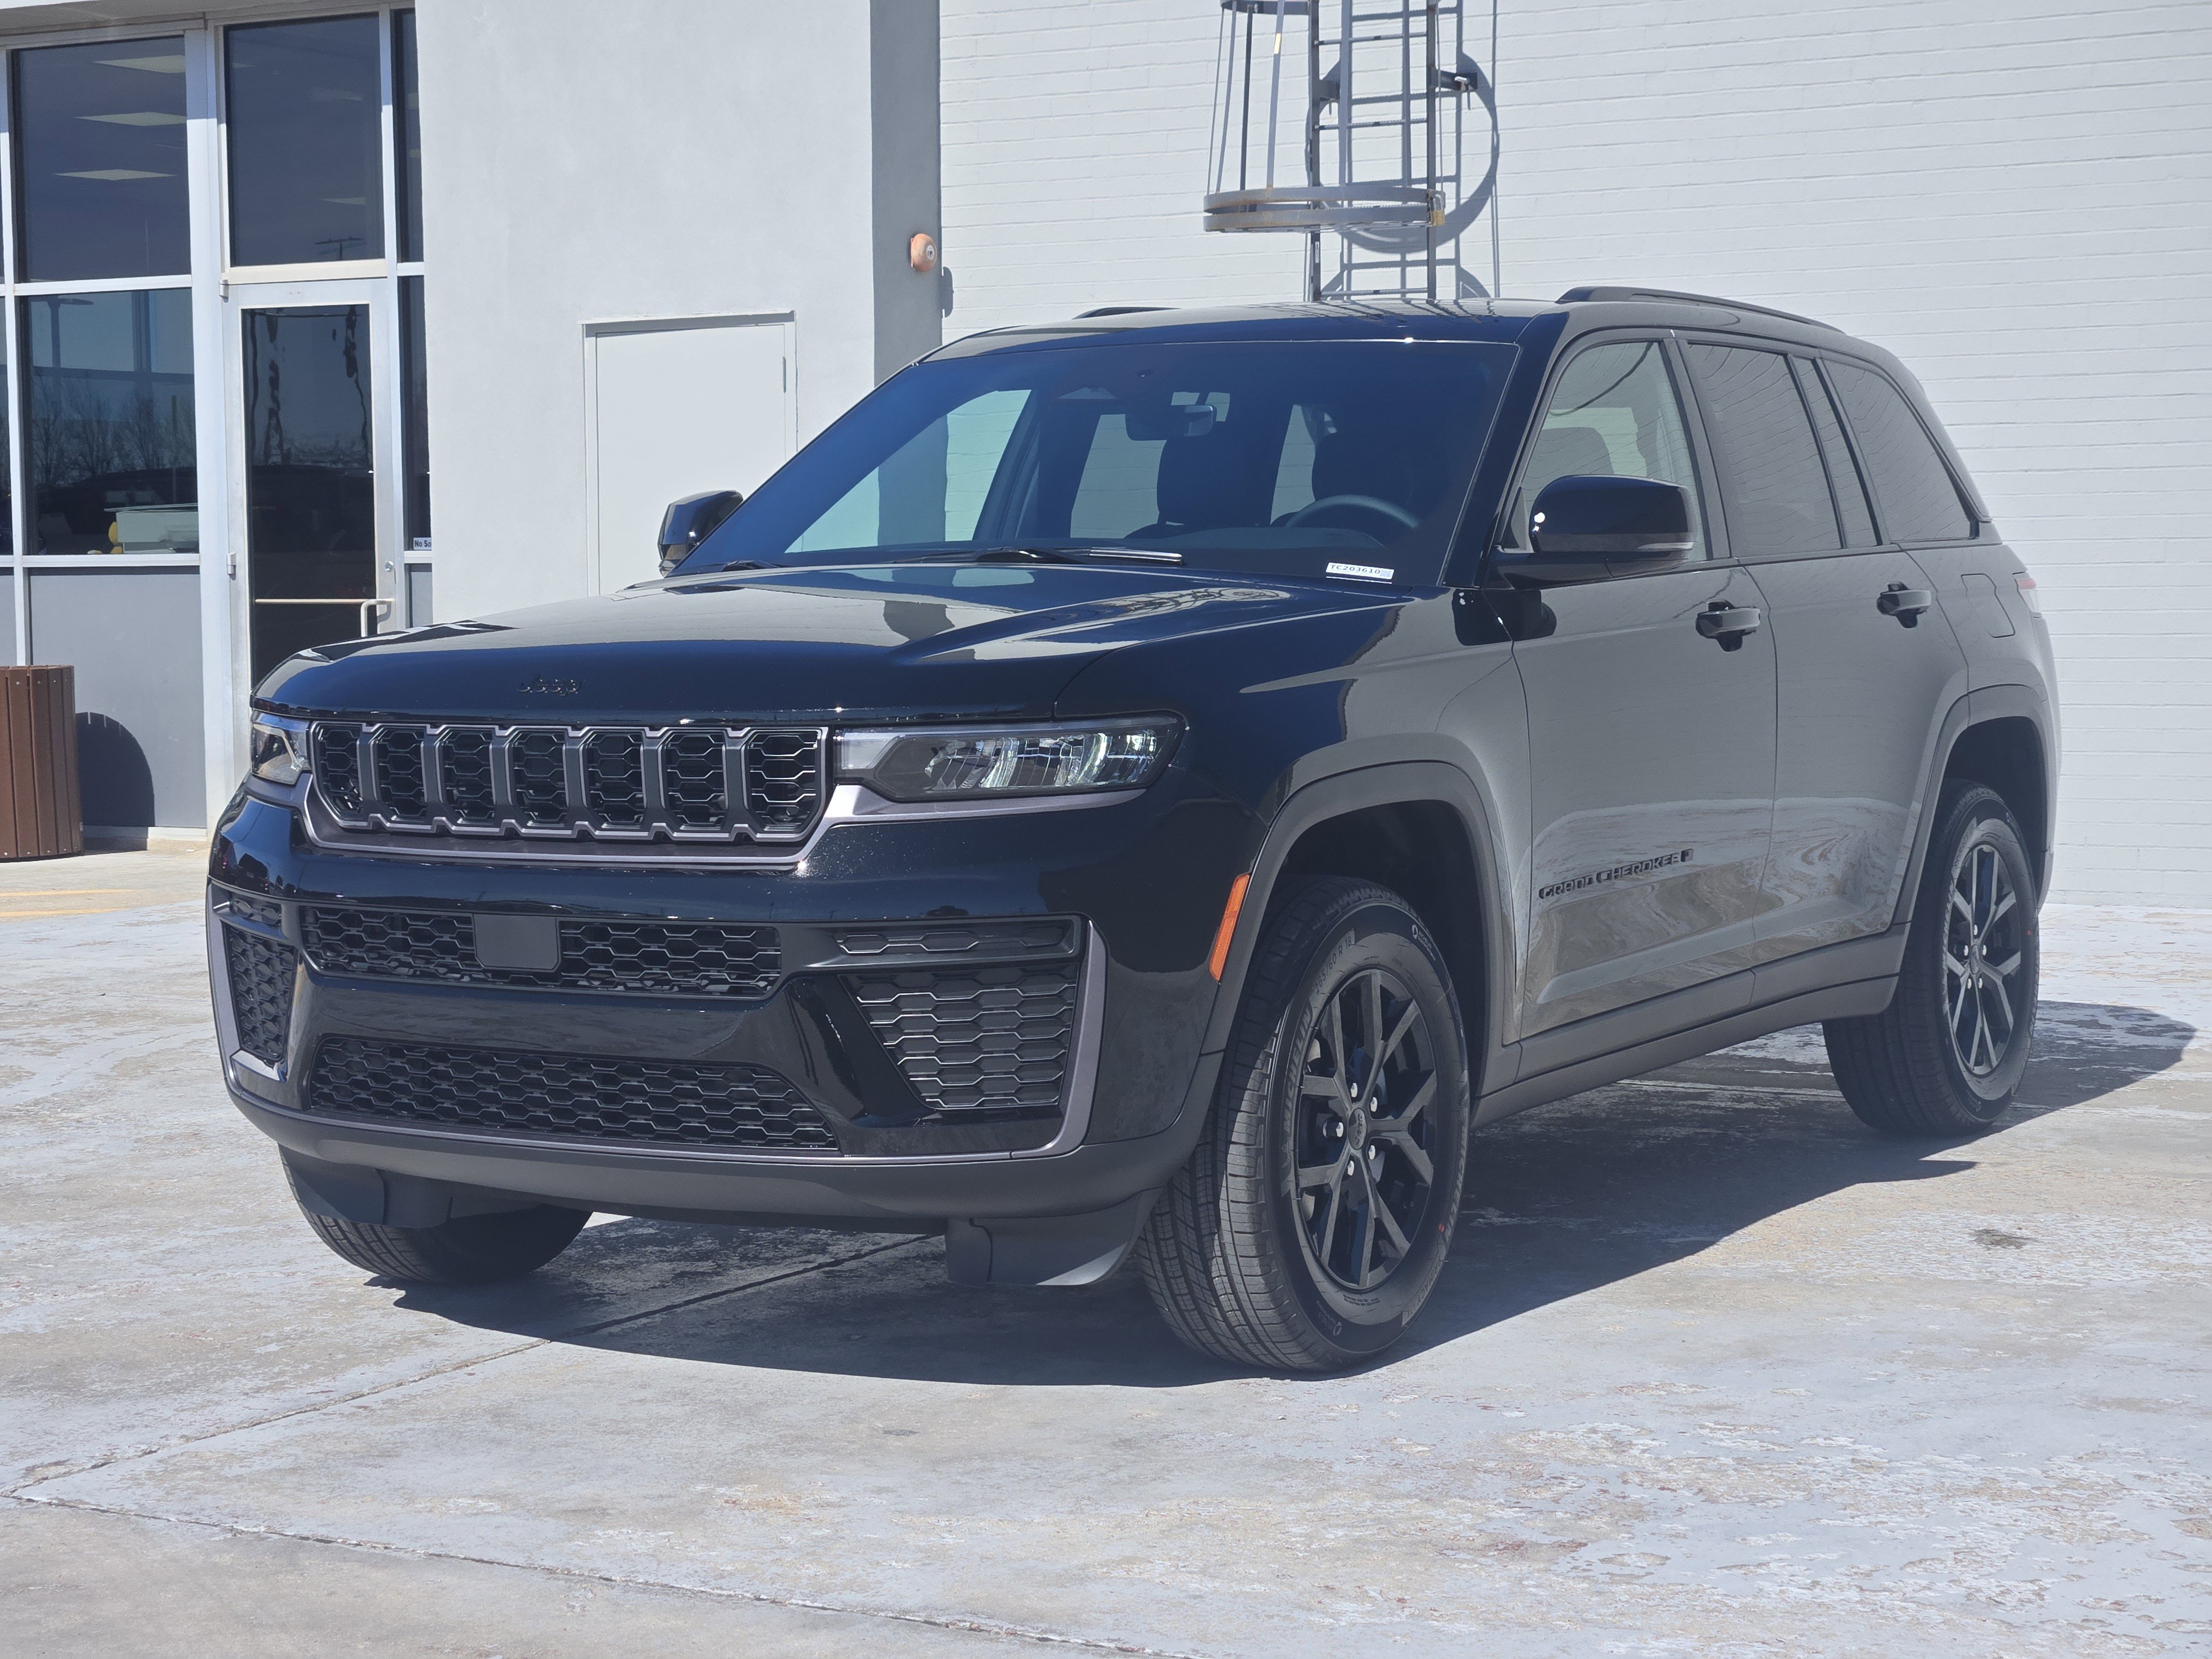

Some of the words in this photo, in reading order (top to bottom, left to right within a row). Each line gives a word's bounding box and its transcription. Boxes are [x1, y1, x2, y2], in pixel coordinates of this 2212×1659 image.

[1330, 564, 1381, 574] TC203610
[1538, 874, 1594, 899] GRAND
[1596, 852, 1681, 883] CHEROKEE
[1284, 1006, 1311, 1134] MICHELIN
